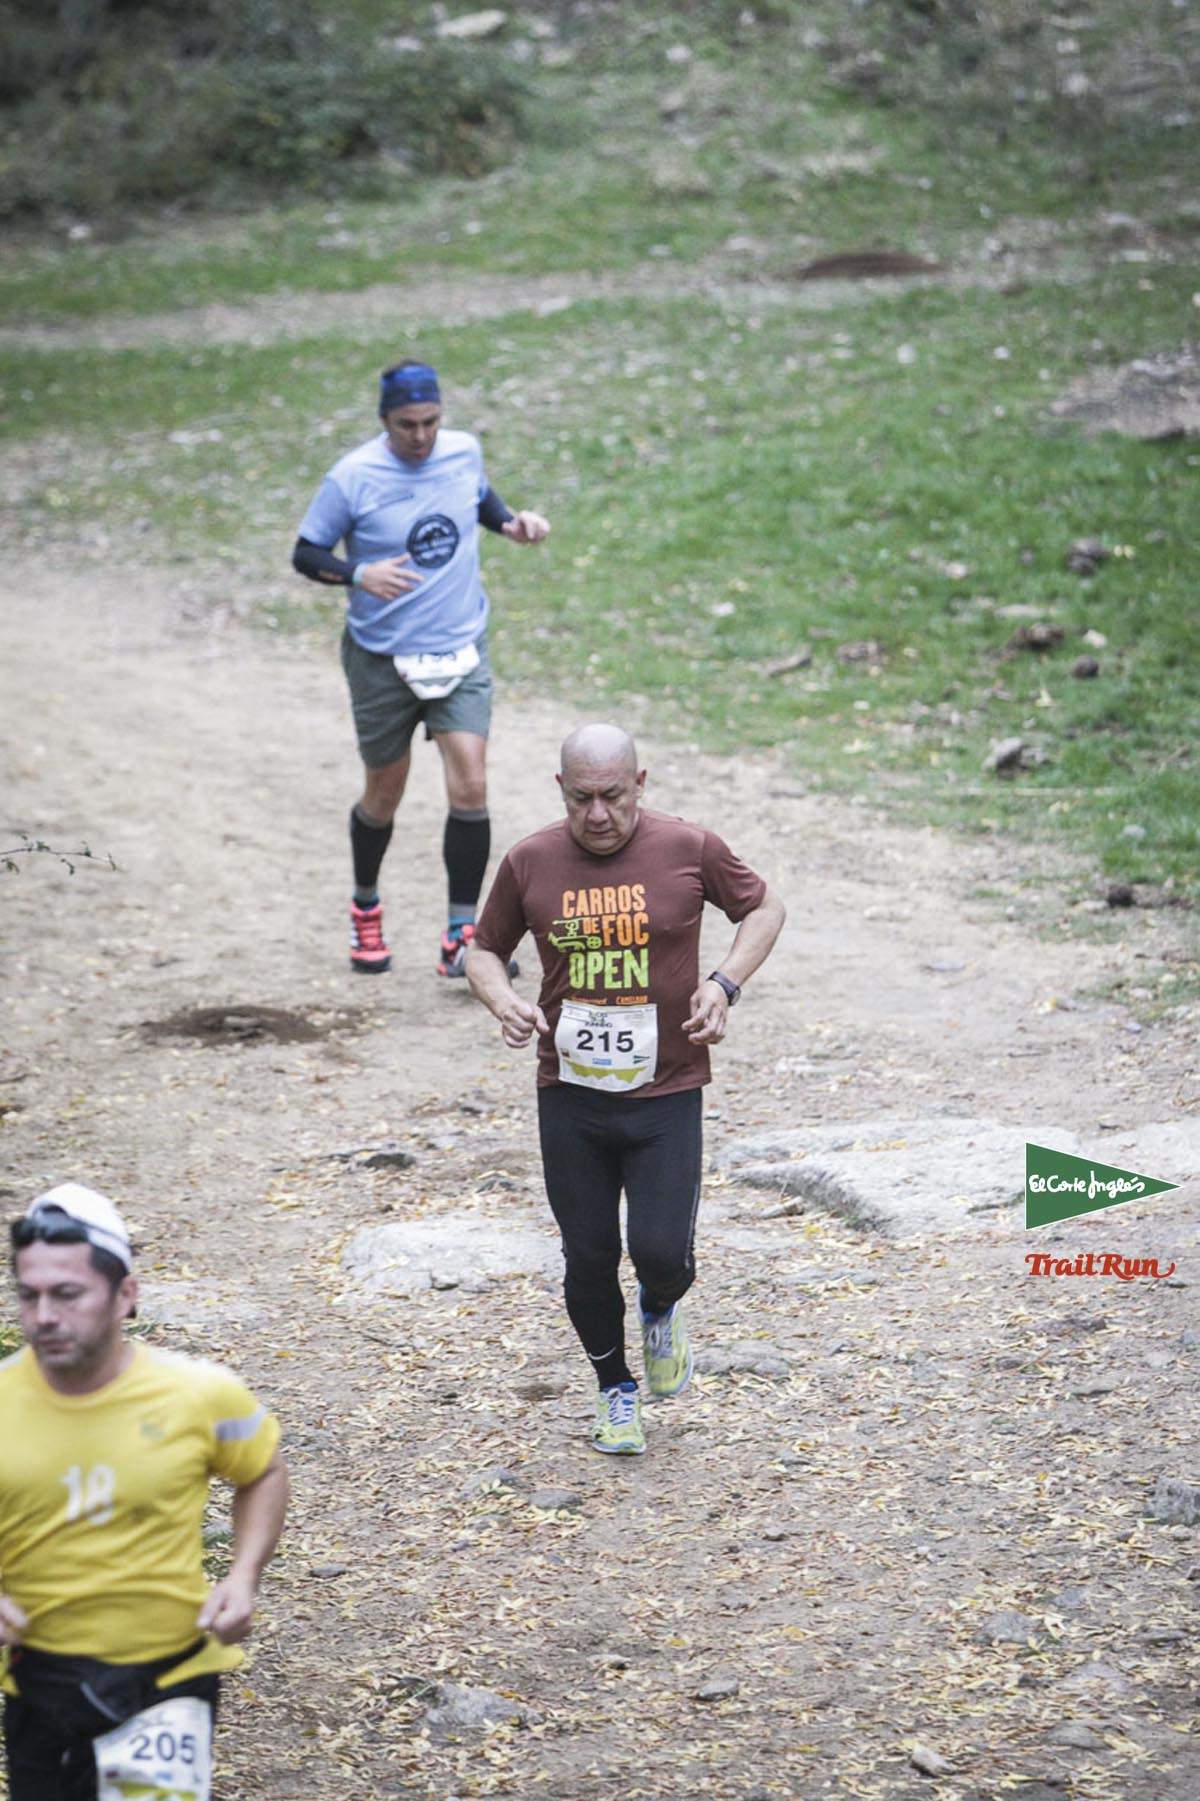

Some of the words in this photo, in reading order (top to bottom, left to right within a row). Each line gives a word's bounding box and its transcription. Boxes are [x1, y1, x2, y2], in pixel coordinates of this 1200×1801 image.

[562, 883, 647, 918] CARROS
[582, 917, 600, 935] DE
[602, 911, 650, 947] FOC
[569, 948, 649, 990] OPEN
[576, 1028, 635, 1053] 215
[129, 1731, 197, 1765] 205
